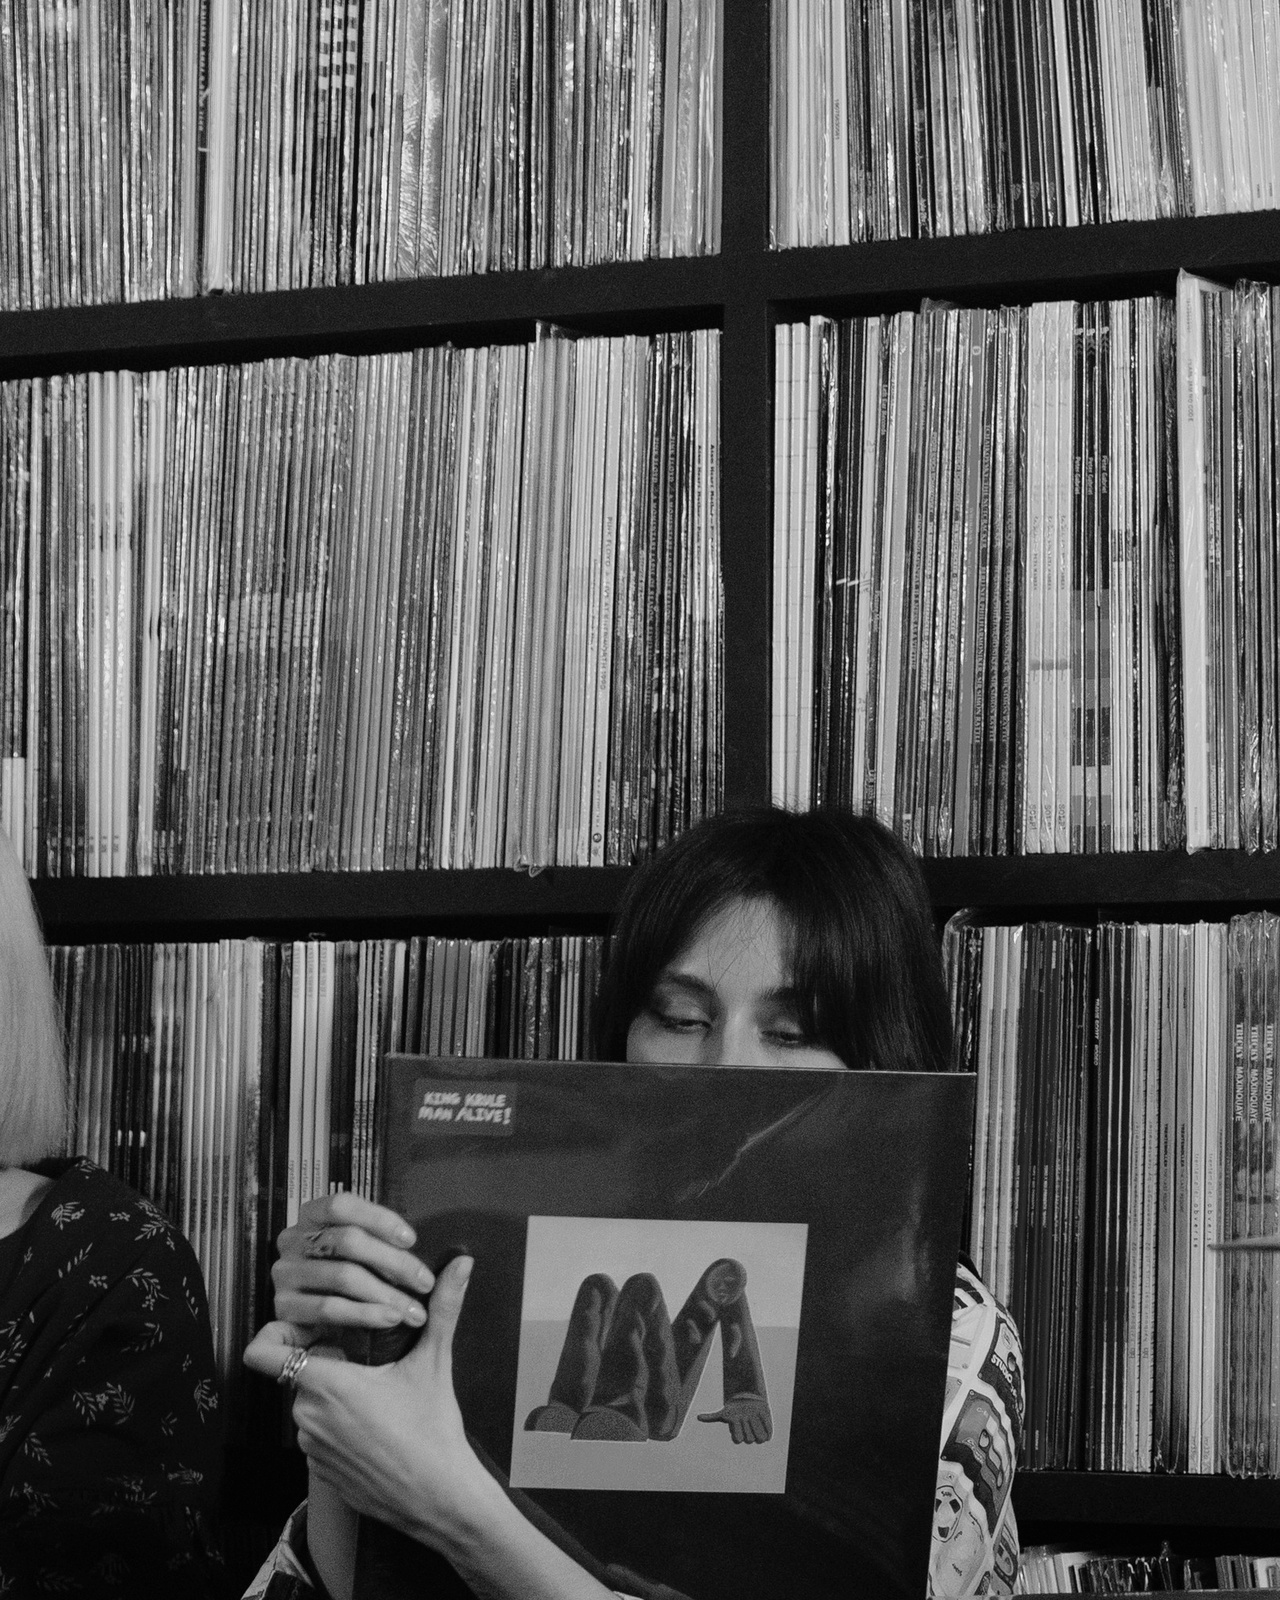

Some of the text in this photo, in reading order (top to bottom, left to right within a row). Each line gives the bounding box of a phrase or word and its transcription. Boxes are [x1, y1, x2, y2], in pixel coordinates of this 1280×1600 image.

[1074, 455, 1082, 495] Peter Gabriel
[1086, 456, 1095, 496] Peter Gabriel
[1100, 455, 1109, 494] Peter Gabriel
[605, 516, 613, 537] PINK
[604, 539, 612, 568] FLOYD
[602, 602, 610, 612] AT
[1235, 1022, 1244, 1122] TRICKY MAXINQUAYE
[1249, 1025, 1259, 1124] TRICKY MAXINQUAYE
[1264, 1023, 1274, 1123] TRICKY MAXINQUAYE
[417, 1106, 512, 1125] MAN ALIVE!
[423, 1091, 507, 1108] KING KRULE
[990, 1353, 1014, 1384] STUDIO
